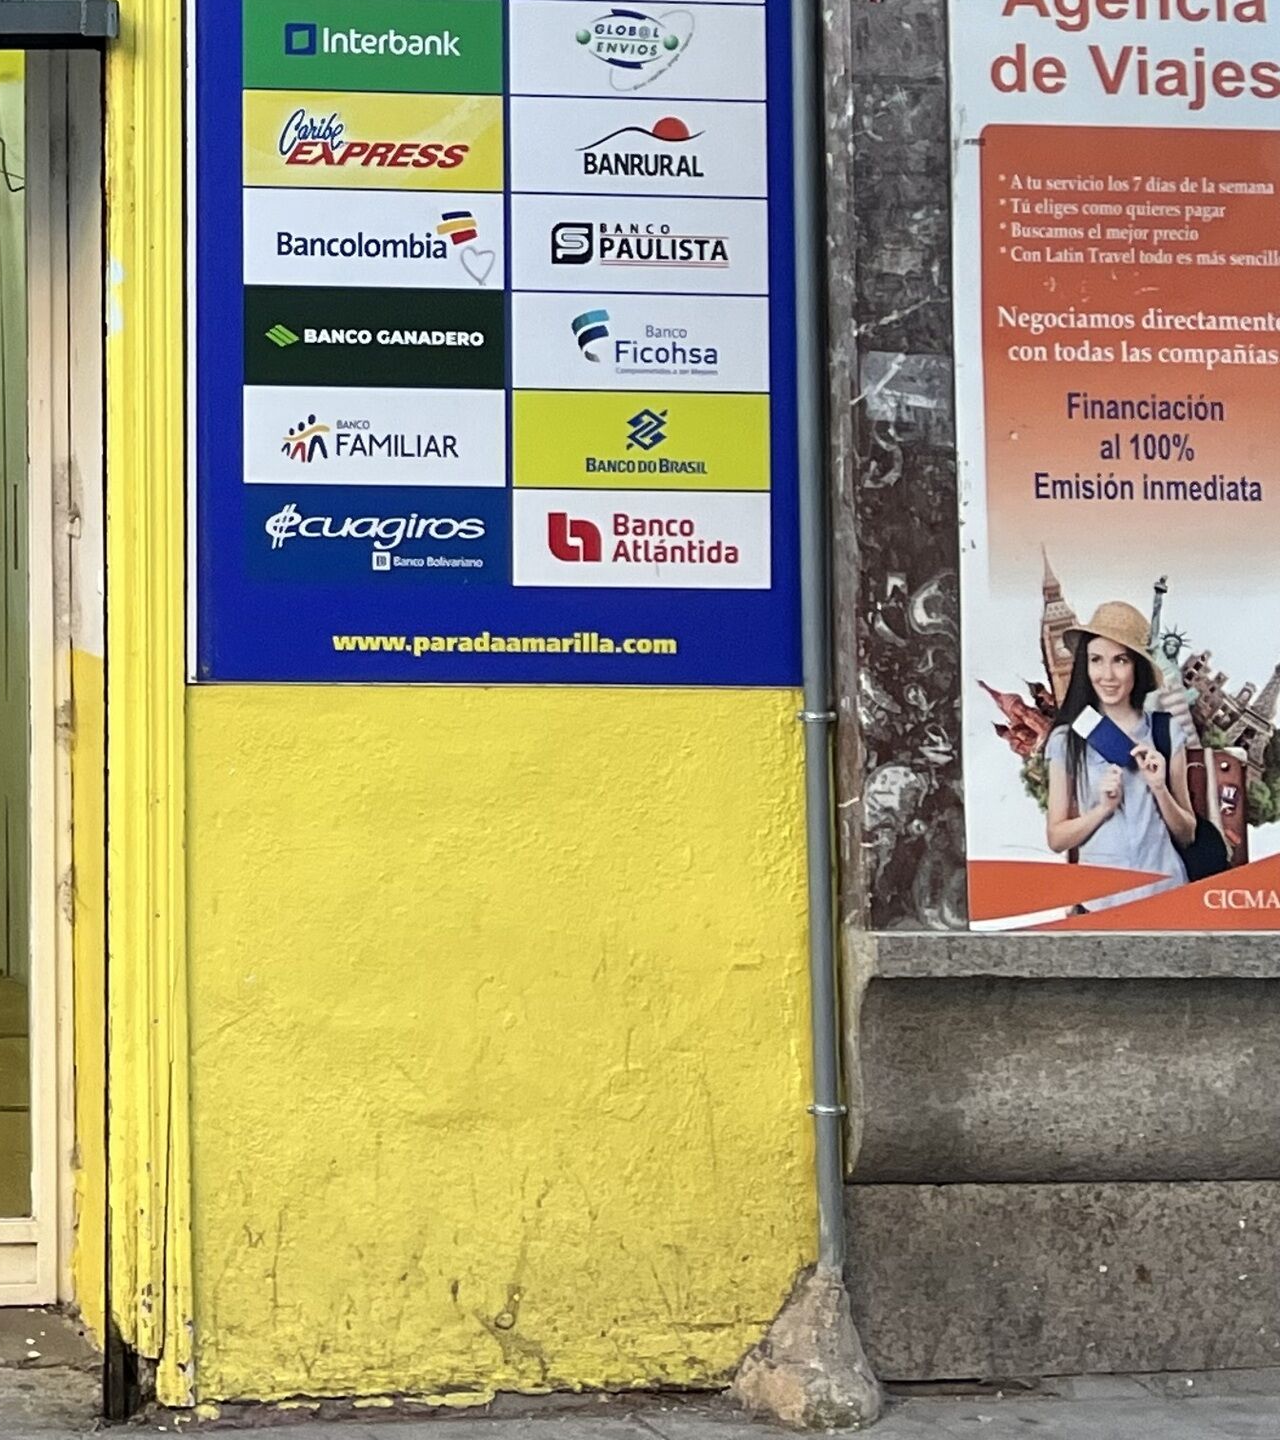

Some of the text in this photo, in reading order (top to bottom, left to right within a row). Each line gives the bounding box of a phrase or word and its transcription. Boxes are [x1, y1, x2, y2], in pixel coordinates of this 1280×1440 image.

[323, 27, 461, 57] Interbank
[596, 42, 658, 56] ENVIOS
[990, 43, 1280, 111] de Viajes
[278, 109, 345, 155] Caribe
[285, 141, 470, 169] EXPRESS
[583, 153, 704, 177] BANRURAL
[1010, 174, 1023, 190] A
[1027, 176, 1042, 191] tu
[1046, 176, 1104, 192] servicio
[1107, 175, 1130, 192] los
[1133, 176, 1142, 192] 7
[1179, 177, 1198, 193] de
[1201, 177, 1215, 193] la
[1219, 182, 1275, 195] semana
[1010, 198, 1226, 222] Tú eliges como quieres pagar
[599, 223, 671, 234] BANCO
[1011, 221, 1199, 246] Buscamos el mejor precio
[277, 232, 448, 258] Bancolombia
[600, 237, 728, 261] PAULISTA
[1010, 246, 1042, 263] Con
[1045, 246, 1084, 263] Latin
[1087, 247, 1136, 264] Travel
[1138, 248, 1173, 265] todo
[1176, 253, 1192, 265] es
[1196, 250, 1227, 266] más
[645, 325, 688, 338] Banco
[998, 306, 1135, 334] Negociamos
[304, 328, 484, 347] BANCO GANADERO
[615, 340, 718, 364] Ficohsa
[1007, 341, 1280, 370] con todas las compañías
[1067, 392, 1225, 422] Financiación
[336, 420, 370, 430] BANCO
[336, 434, 459, 458] FAMILIAR
[1100, 435, 1195, 462] al 100%
[586, 457, 707, 474] BANCO DO BRASIL
[1034, 473, 1263, 503] Emisión inmediata
[613, 513, 695, 537] Banco
[393, 556, 425, 567] Banco
[612, 539, 739, 564] Atlántida
[332, 632, 677, 656] www.paradaamarilla.com
